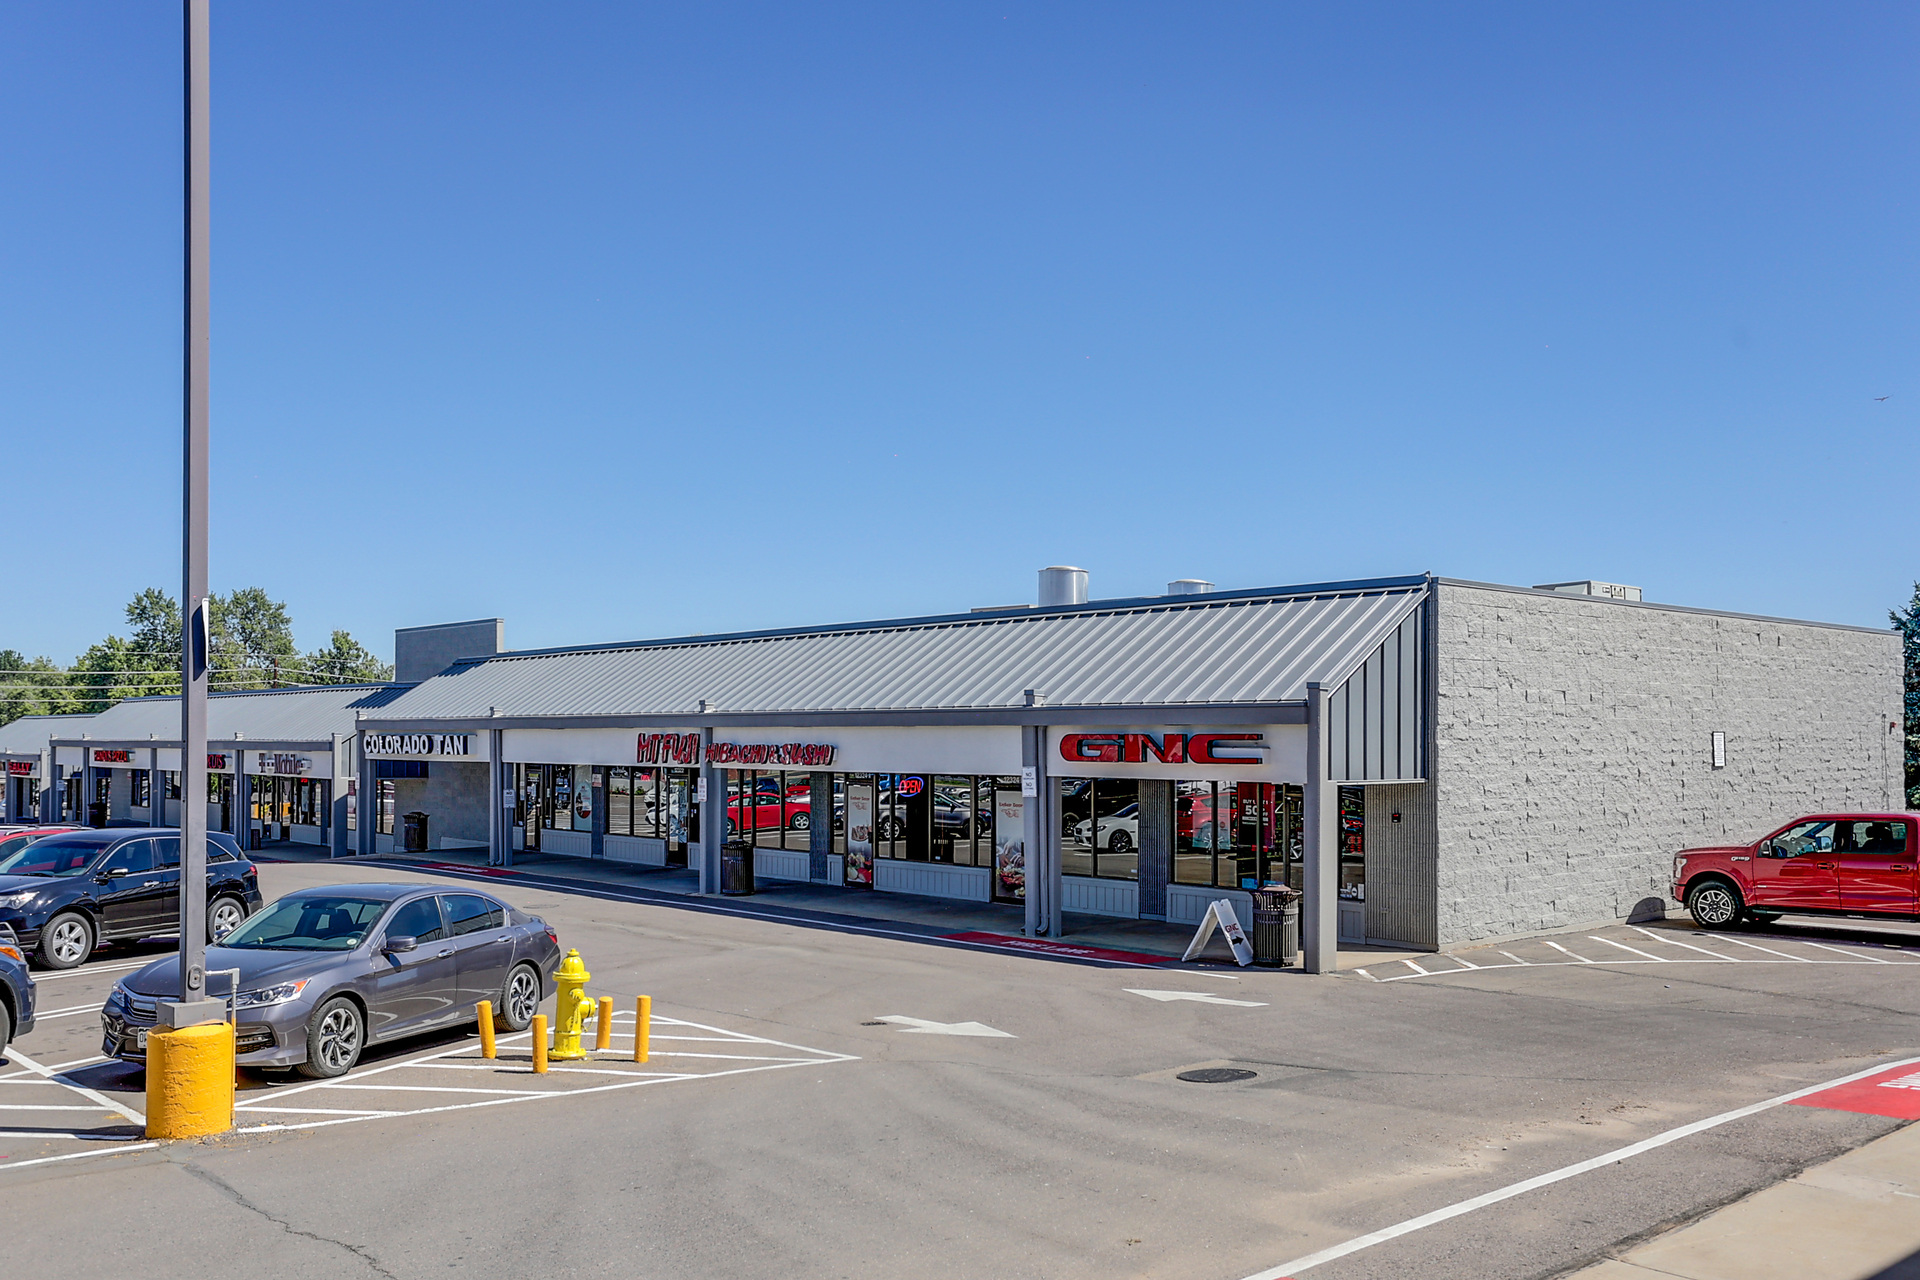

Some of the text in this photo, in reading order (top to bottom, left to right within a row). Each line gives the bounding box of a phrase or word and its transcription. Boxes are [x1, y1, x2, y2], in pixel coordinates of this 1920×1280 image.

[363, 734, 465, 755] COLORADO TAN
[662, 733, 700, 764] FUJI
[705, 743, 767, 764] HIBACHI
[780, 743, 833, 766] SUSHI
[1060, 734, 1264, 764] GNC
[8, 761, 32, 771] SALLY
[899, 780, 921, 793] OPEN
[1225, 923, 1239, 933] GNC
